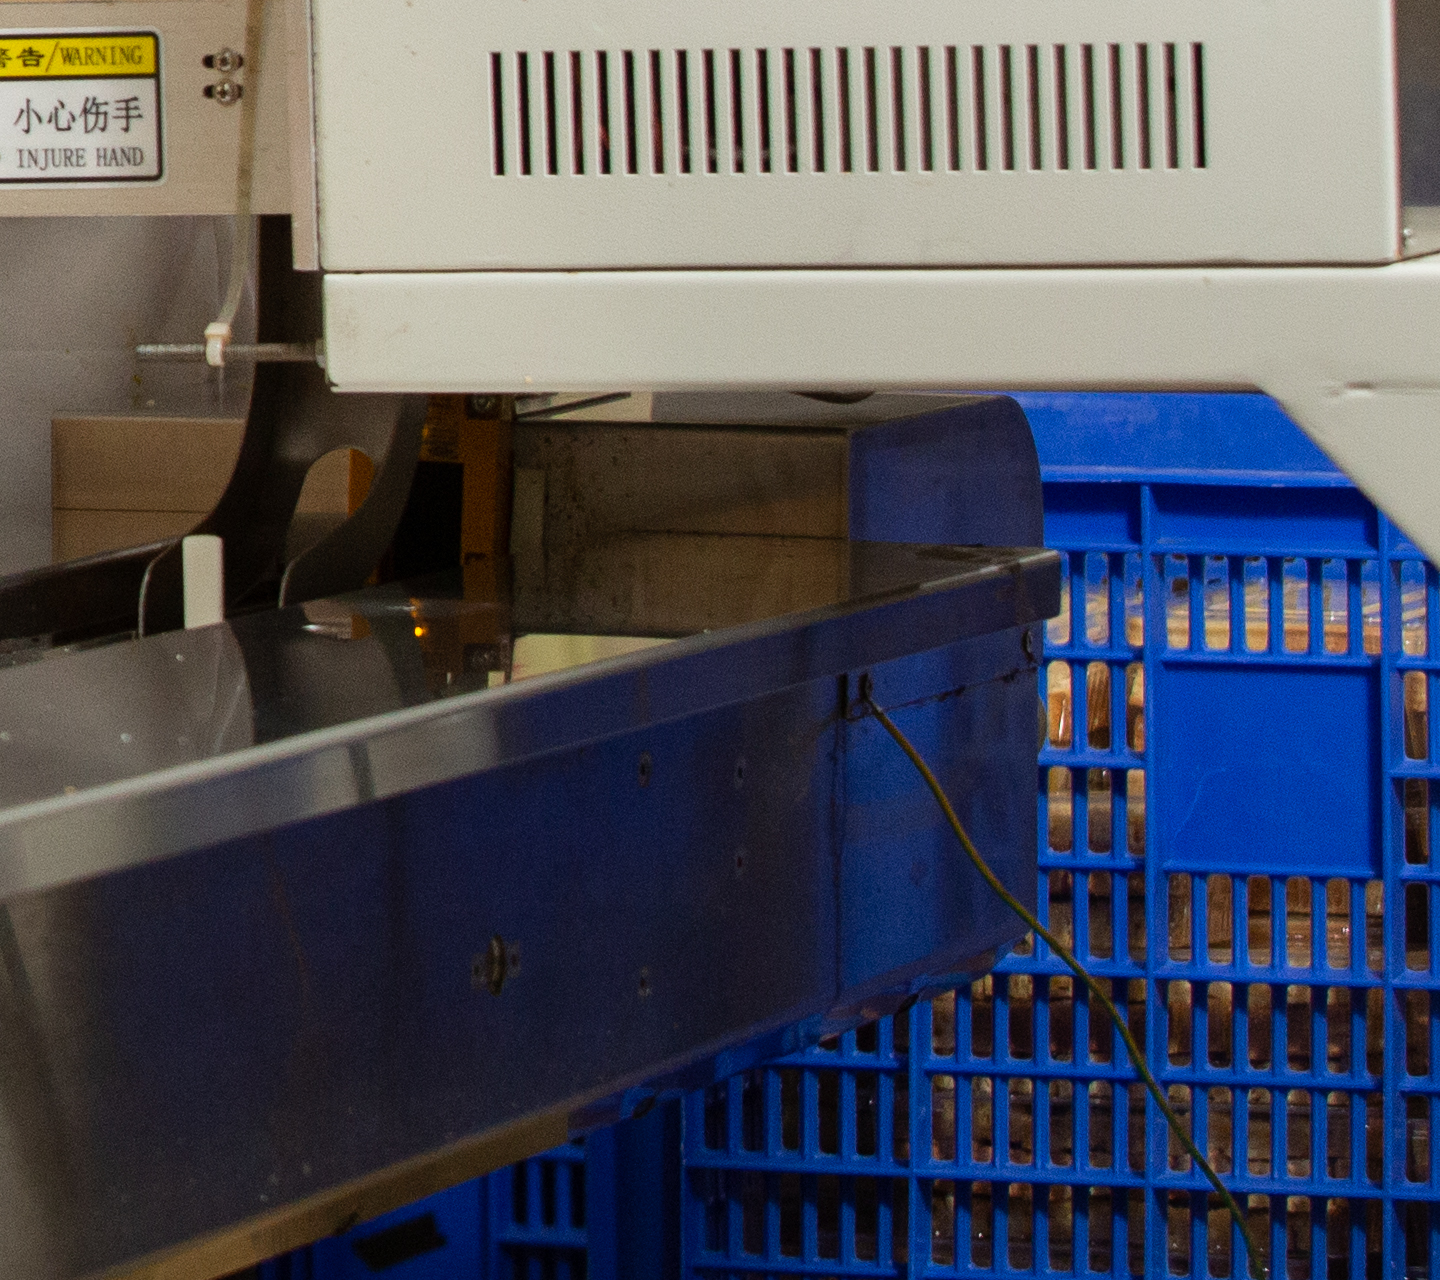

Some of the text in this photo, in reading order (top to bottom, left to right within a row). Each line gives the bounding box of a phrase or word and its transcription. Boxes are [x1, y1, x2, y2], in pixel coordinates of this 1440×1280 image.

[13, 96, 144, 134] 小心伤手
[17, 146, 144, 170] INJURE HAND
